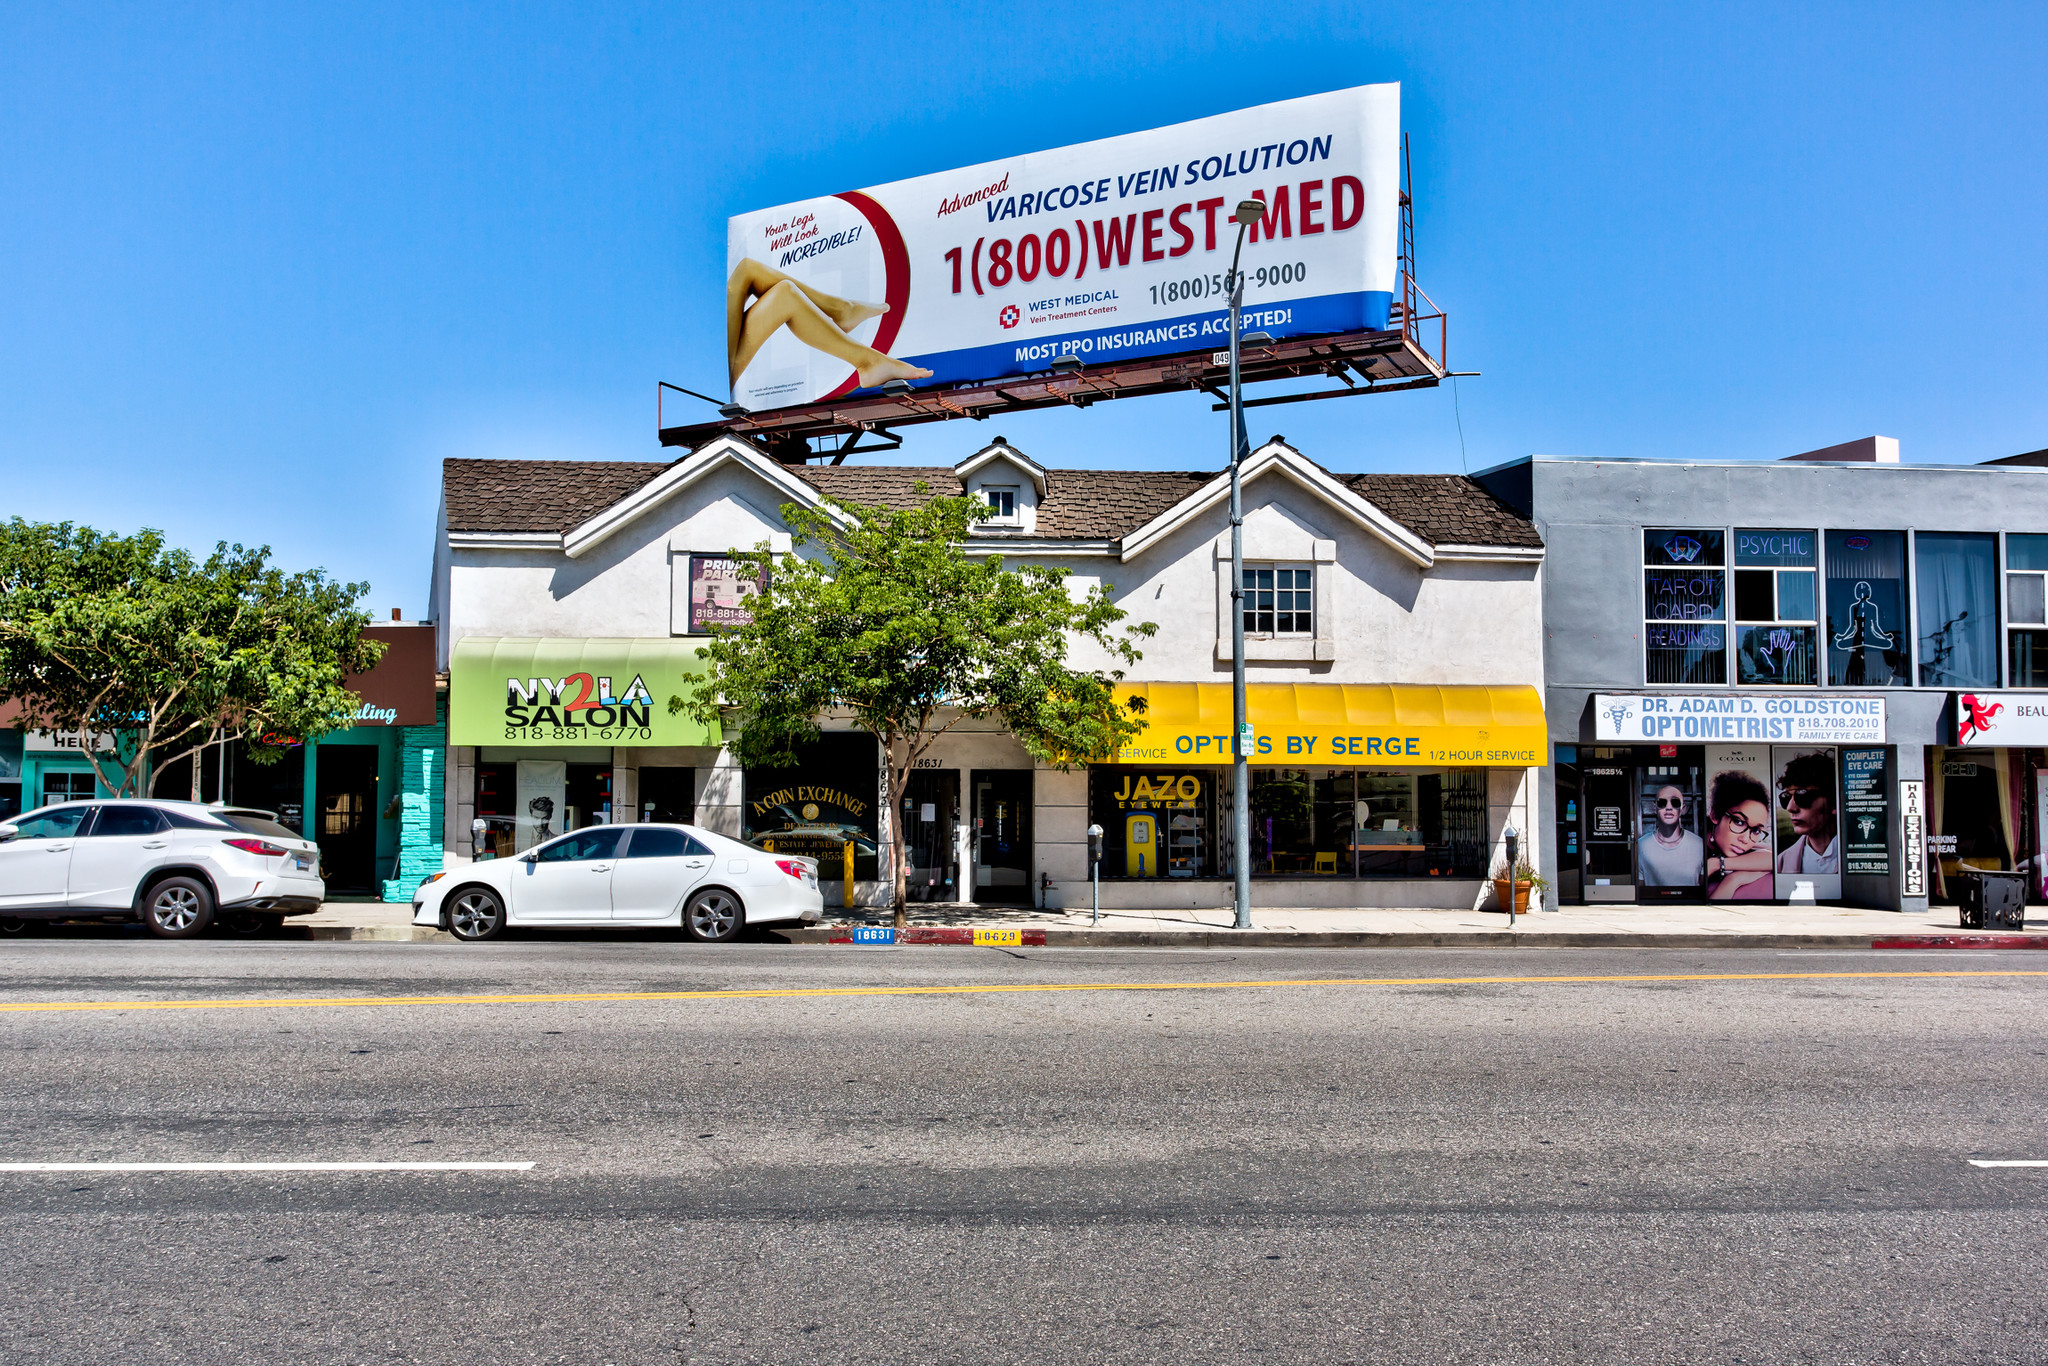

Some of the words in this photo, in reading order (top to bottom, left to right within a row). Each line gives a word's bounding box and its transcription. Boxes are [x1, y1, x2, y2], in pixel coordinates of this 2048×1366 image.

[986, 178, 1111, 223] VARICOSE
[1117, 163, 1179, 198] VEIN
[1185, 135, 1332, 186] SOLUTION
[937, 172, 1009, 218] Advanced
[764, 222, 788, 238] Your
[791, 213, 815, 230] Legs
[770, 233, 792, 252] Will
[794, 224, 820, 243] Look
[779, 225, 863, 268] INCREDIBLE!
[1028, 297, 1062, 312] WEST
[1064, 289, 1119, 309] MEDICAL
[1030, 312, 1048, 324] Vein
[1048, 308, 1087, 321] Treatment
[1088, 304, 1117, 316] Centers
[1015, 342, 1058, 362] MOST
[1061, 338, 1094, 355] PPO
[1096, 322, 1198, 351] INSURANCES
[1739, 535, 1808, 556] PSYCHIC
[1651, 578, 1717, 597] TAROT
[1654, 602, 1714, 621] CARD
[1649, 628, 1721, 648] READINGS
[1642, 698, 1673, 713] DR.
[1679, 699, 1734, 713] ADAM
[1740, 699, 1757, 714] D.
[1765, 700, 1880, 715] GOLDSTONE
[504, 706, 650, 727] SALON
[1798, 718, 1879, 729] 818.708.2010
[504, 727, 652, 740] 818-881-6770
[1641, 716, 1794, 739] OPTOMETRIST
[1798, 731, 1832, 740] FAMILY
[1834, 732, 1851, 740] EYE
[1853, 732, 1879, 741] CARE
[1118, 748, 1167, 759] SERVICE
[1176, 735, 1272, 755] OPTIS
[1286, 736, 1318, 755] BY
[1331, 736, 1420, 756] SERGE
[912, 758, 943, 768] 18631
[1430, 750, 1446, 760] 1/2
[1449, 751, 1483, 760] HOUR
[1486, 751, 1535, 761] SERVICE
[1846, 751, 1885, 761] COMPLETE
[1848, 762, 1861, 770] EYE
[1863, 761, 1883, 770] CARE
[1942, 763, 1976, 775] OPEN
[1114, 775, 1201, 801] JAZO
[753, 802, 766, 817] A
[763, 787, 795, 810] COIN
[798, 786, 868, 817] EXCHANGE
[1118, 801, 1196, 809] EYEWEAR
[1908, 784, 1917, 814] HAIR
[784, 822, 827, 831] DEALERS
[829, 822, 839, 831] IN
[1927, 835, 1957, 845] PARKING
[1928, 845, 1936, 854] IN
[1937, 845, 1956, 854] REAR
[1906, 816, 1921, 893] EXTENSIONS
[1848, 862, 1889, 870] 818.708.2010
[858, 931, 890, 940] 18631
[978, 931, 1015, 941] 18629
